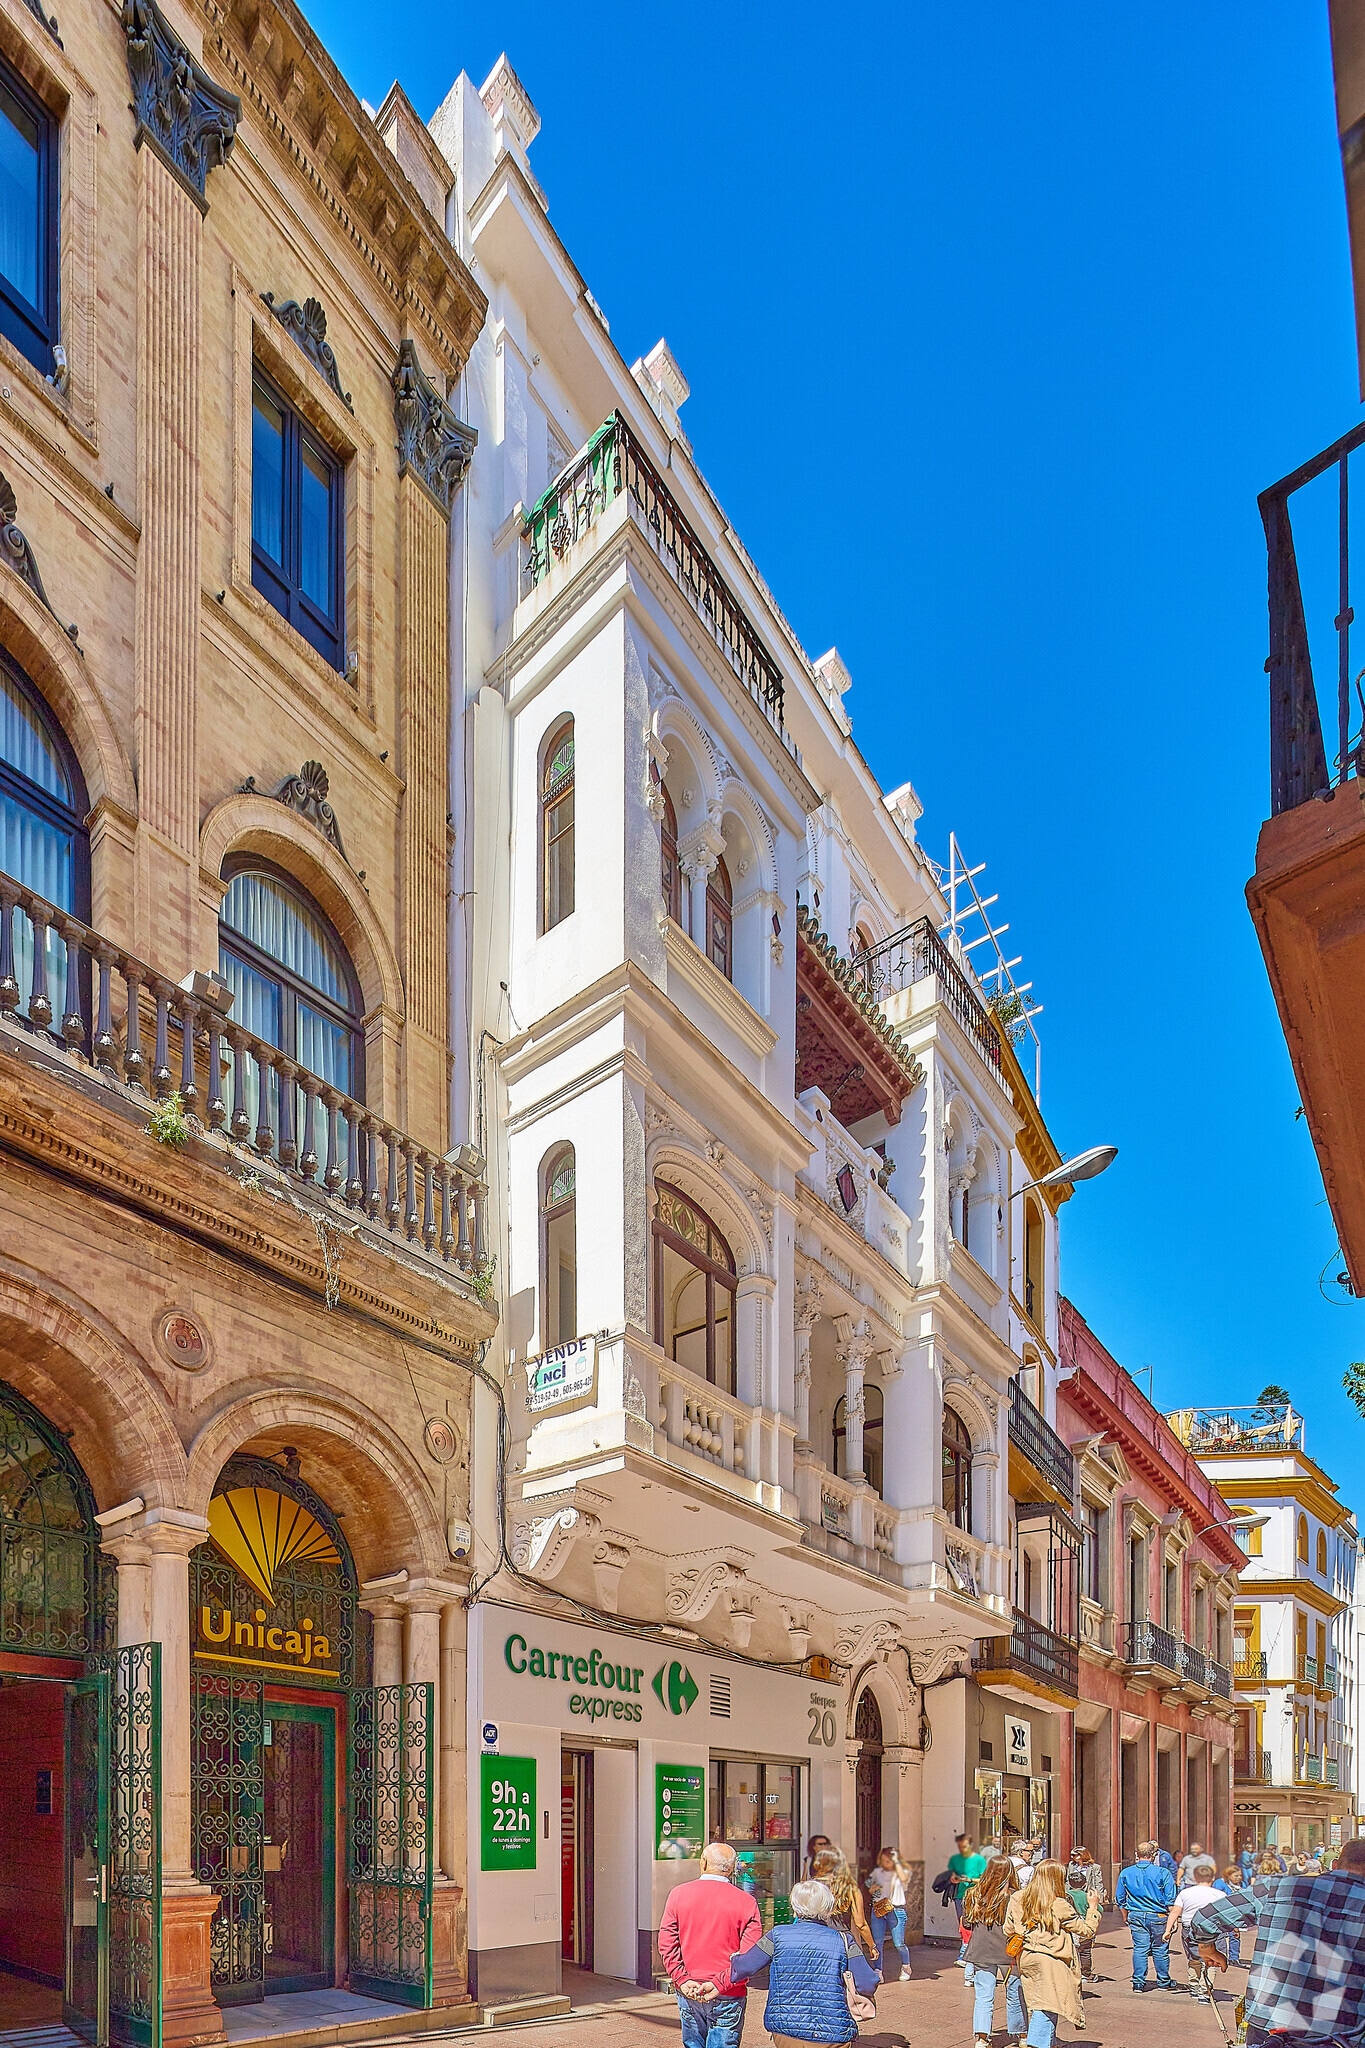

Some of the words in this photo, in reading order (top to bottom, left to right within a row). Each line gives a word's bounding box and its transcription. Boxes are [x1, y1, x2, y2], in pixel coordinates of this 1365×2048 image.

[534, 1338, 587, 1369] VENDE
[201, 1606, 332, 1664] Unicaja
[505, 1633, 645, 1694] Carrefour
[569, 1694, 643, 1723] express
[810, 1691, 836, 1709] Sierpes
[485, 1729, 496, 1738] ADT
[807, 1708, 837, 1747] 20
[491, 1780, 516, 1804] 9h
[522, 1792, 530, 1804] a
[492, 1807, 530, 1831] 22h
